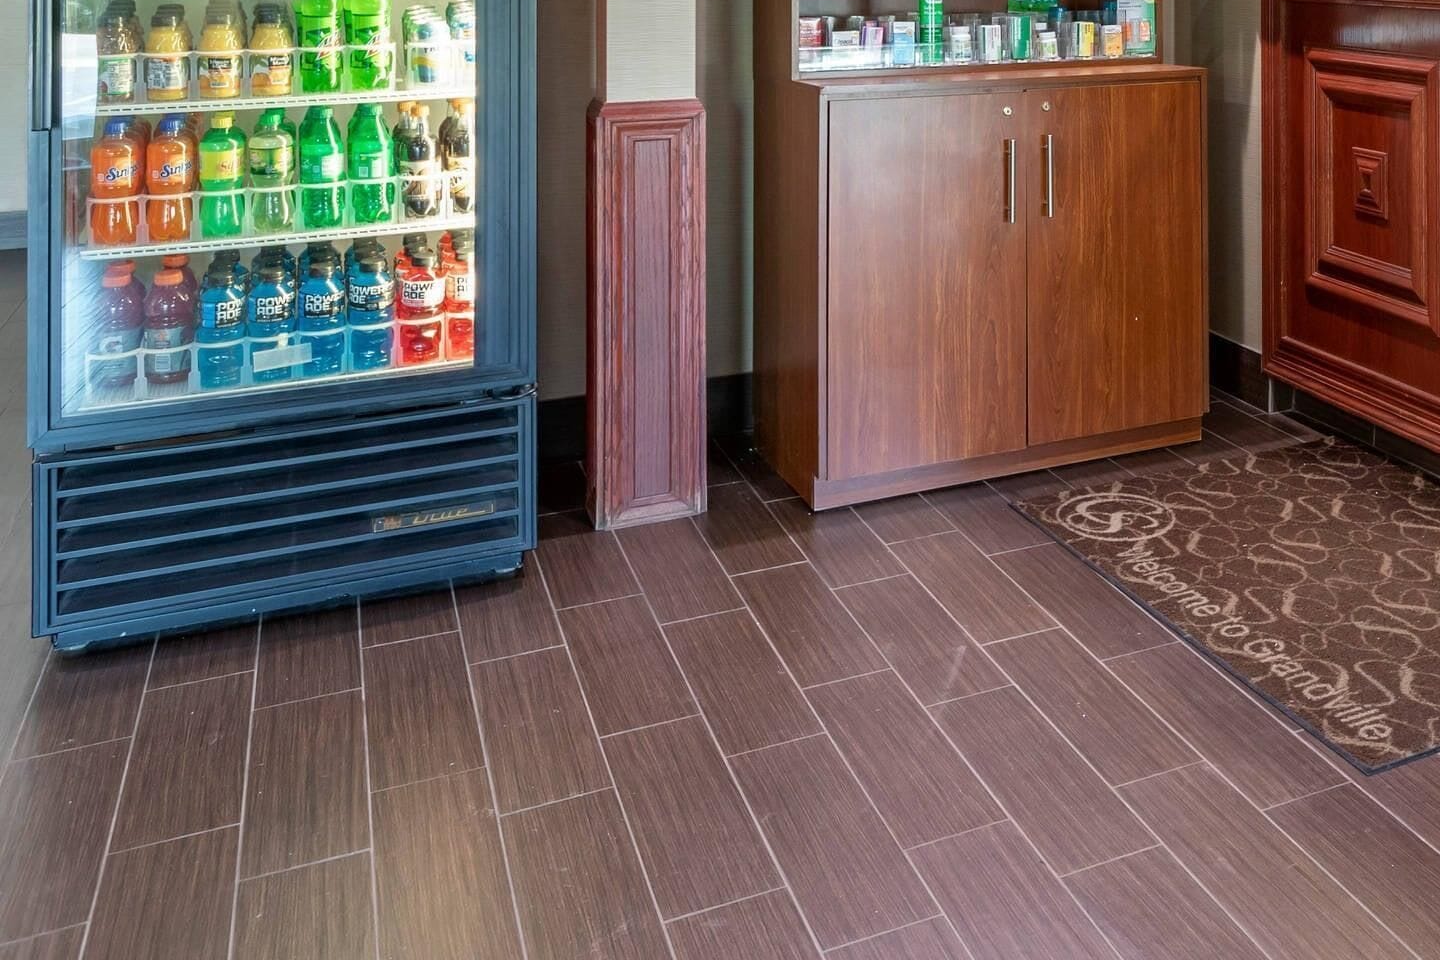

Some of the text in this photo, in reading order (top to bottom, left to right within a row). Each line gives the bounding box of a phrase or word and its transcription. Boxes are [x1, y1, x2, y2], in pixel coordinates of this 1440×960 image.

[257, 305, 283, 315] ADE
[1116, 540, 1393, 741] Welcome to Grandville
